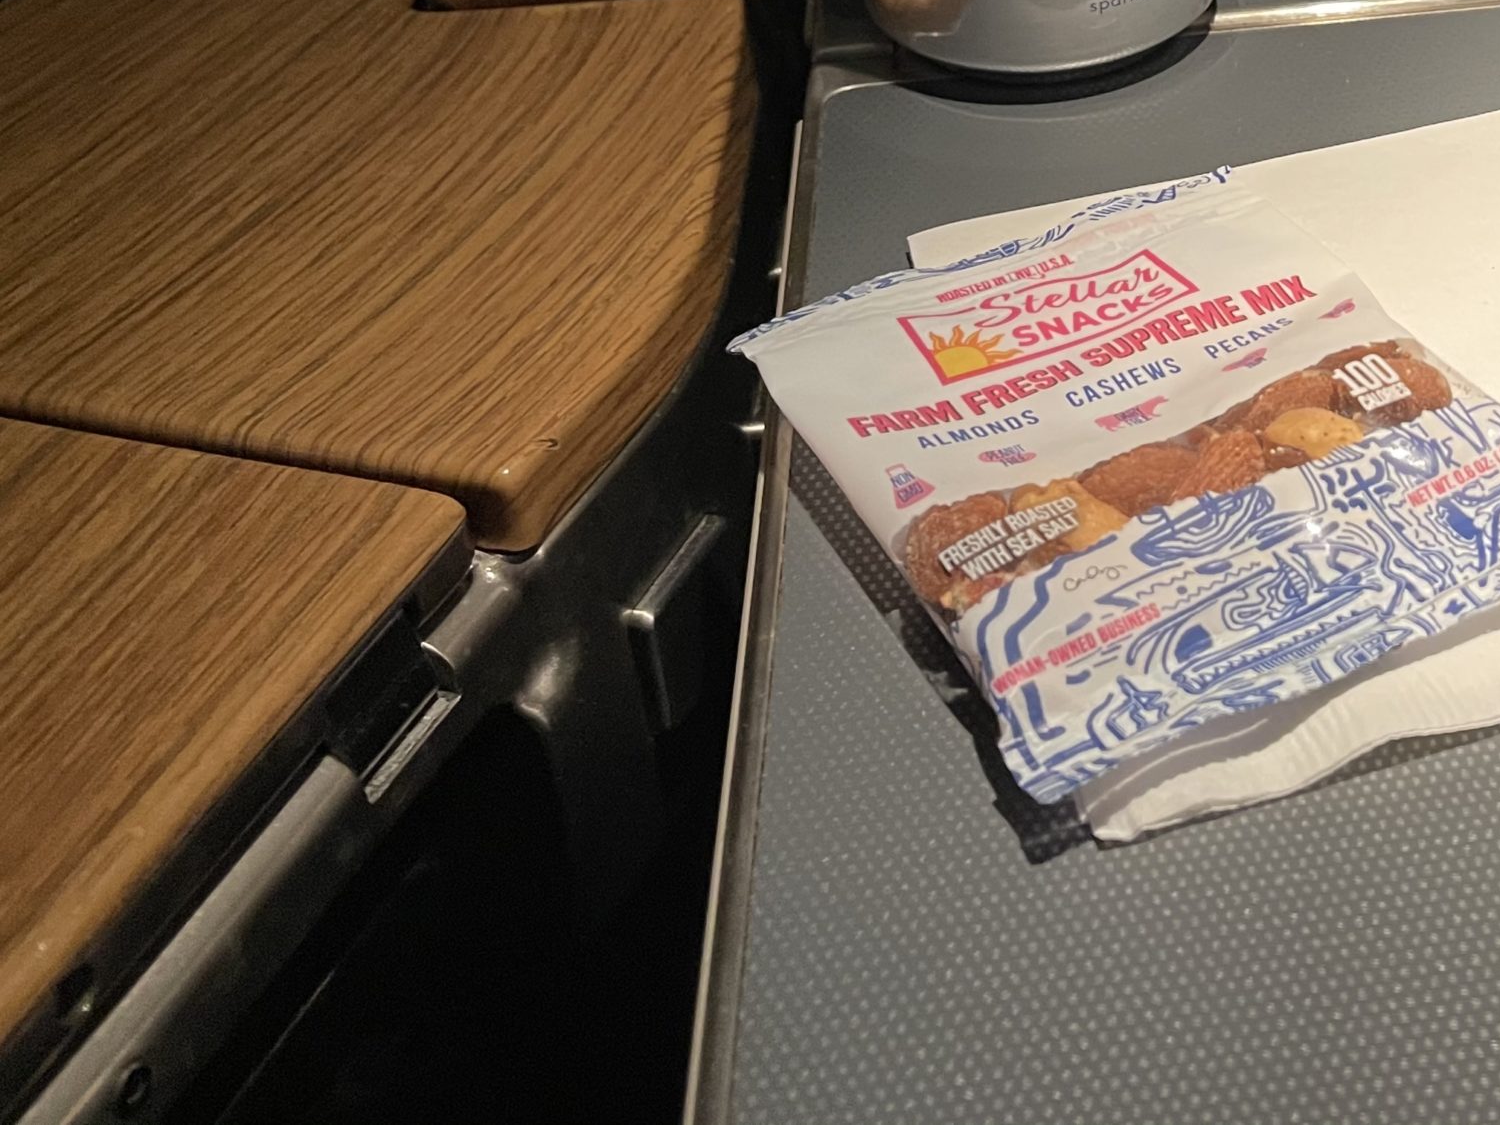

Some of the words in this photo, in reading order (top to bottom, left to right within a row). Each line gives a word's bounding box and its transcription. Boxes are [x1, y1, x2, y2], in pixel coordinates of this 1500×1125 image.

[935, 281, 994, 304] ROASTED
[974, 265, 1160, 330] Stellar
[1011, 283, 1175, 348] SNACKS
[846, 399, 963, 439] FARM
[960, 356, 1084, 417] FRESH
[1079, 295, 1249, 368] SUPREME
[1240, 274, 1319, 316] MIX
[917, 409, 1041, 450] ALMONDS
[1065, 356, 1184, 409] CASHEWS
[1202, 316, 1294, 360] PECANS
[1331, 353, 1400, 397] 100
[1406, 484, 1433, 508] NET
[1453, 463, 1476, 486] 0.6
[938, 518, 1009, 574] FRESHLY
[1003, 495, 1078, 534] ROASTED
[960, 543, 1014, 582] WITH
[1006, 532, 1045, 563] SEA
[1039, 512, 1080, 541] SALT
[991, 631, 1097, 695] WOMAN-OWNED
[1097, 602, 1162, 646] BUSINESS
